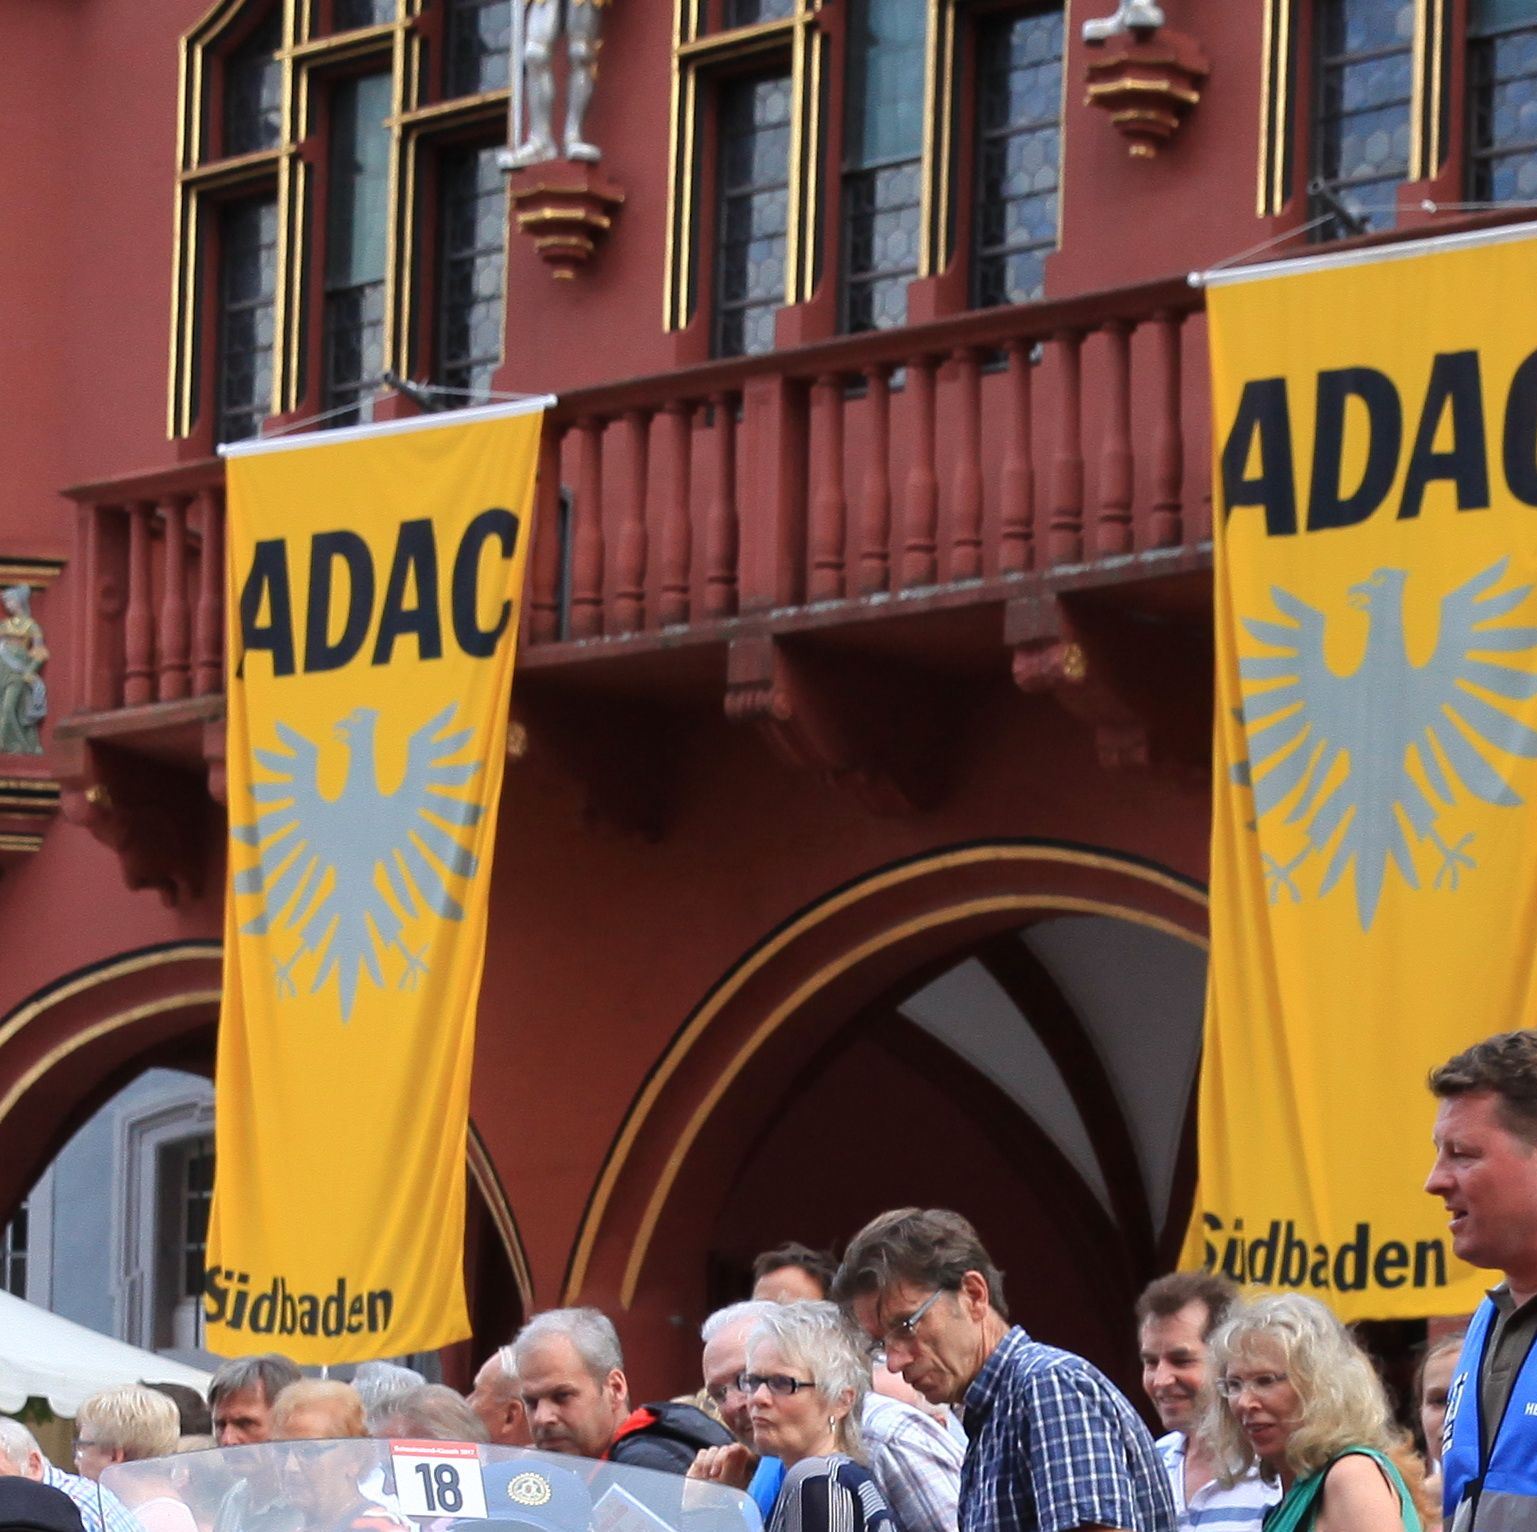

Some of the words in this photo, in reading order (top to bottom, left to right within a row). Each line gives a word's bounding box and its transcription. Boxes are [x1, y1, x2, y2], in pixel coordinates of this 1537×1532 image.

[236, 508, 520, 680] ADAC
[205, 1265, 394, 1337] Südbaden
[414, 1462, 464, 1513] 18
